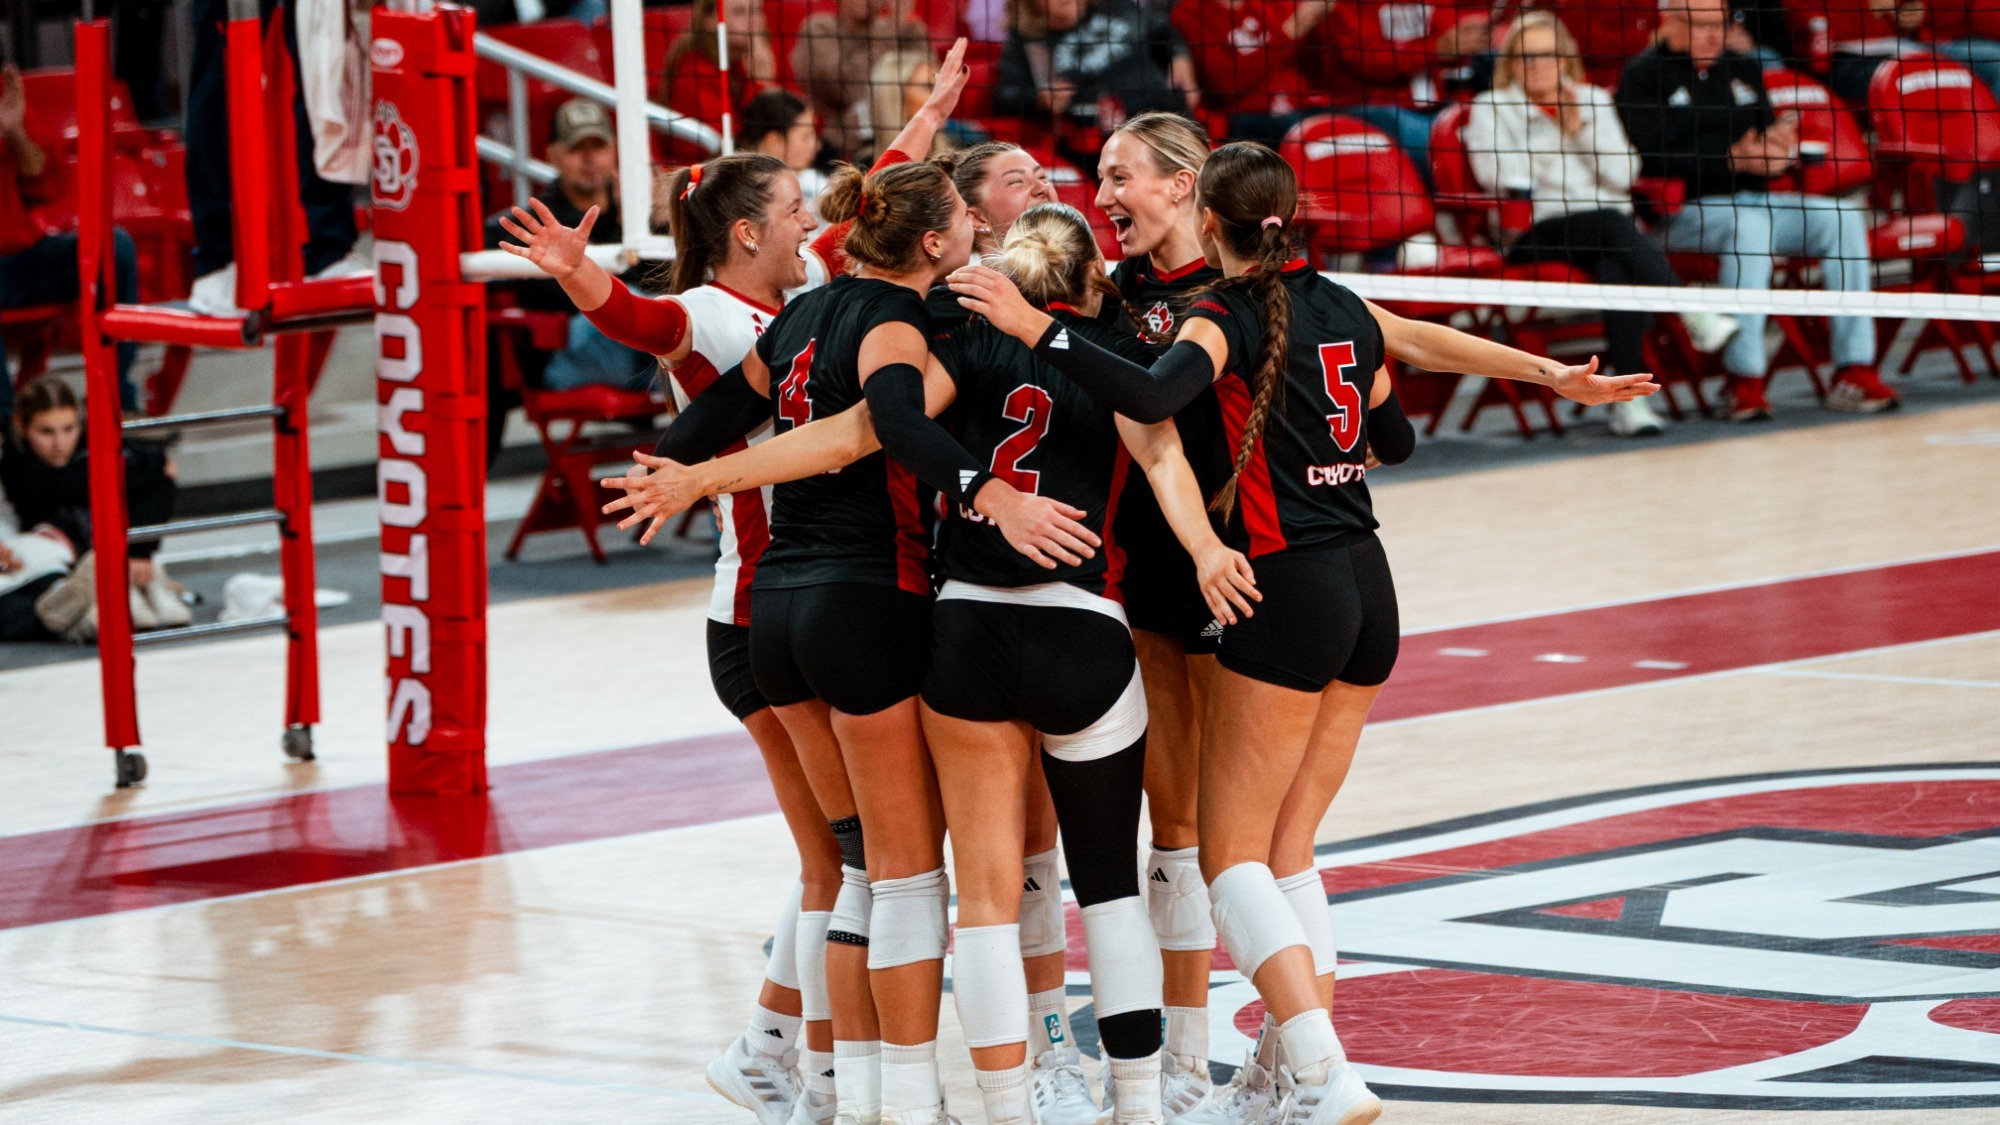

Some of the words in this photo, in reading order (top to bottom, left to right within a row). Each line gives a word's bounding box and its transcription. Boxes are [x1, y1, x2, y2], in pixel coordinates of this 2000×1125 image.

[779, 337, 814, 430] 4
[989, 382, 1054, 497] 2
[1318, 340, 1362, 453] 5
[372, 239, 432, 745] COYOTES
[1307, 463, 1366, 486] COYOT
